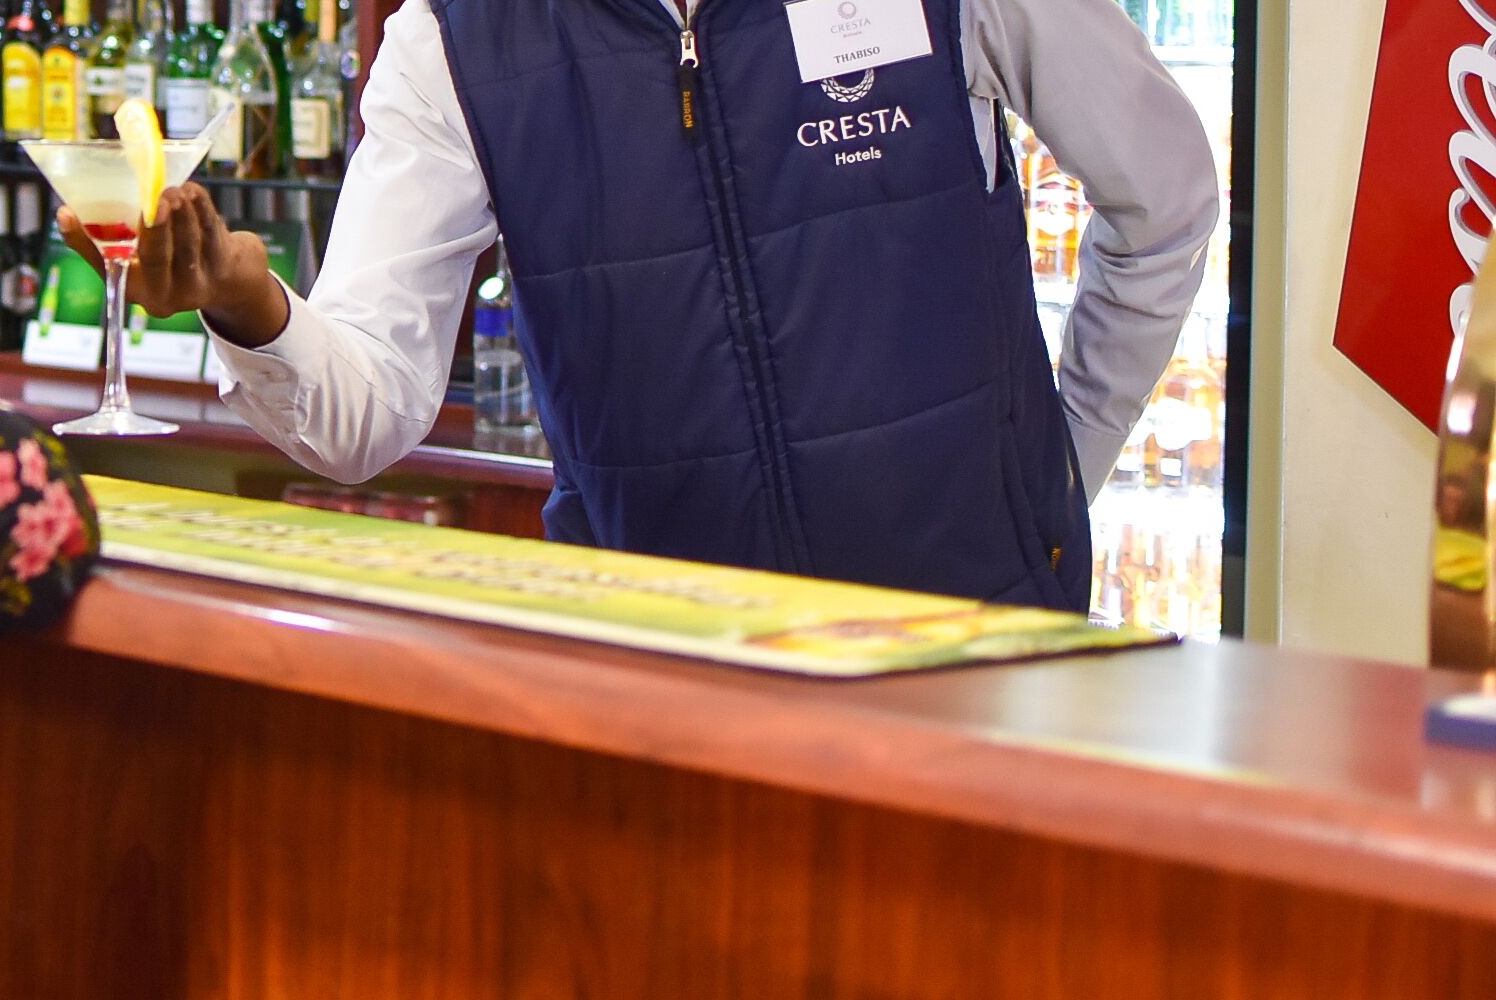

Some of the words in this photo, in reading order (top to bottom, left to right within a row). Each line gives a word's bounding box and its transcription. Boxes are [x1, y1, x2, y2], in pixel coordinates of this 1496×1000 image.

[830, 17, 871, 34] CRESTA
[833, 46, 881, 64] THABISO
[797, 105, 912, 147] CRESTA
[835, 146, 882, 166] Hotels
